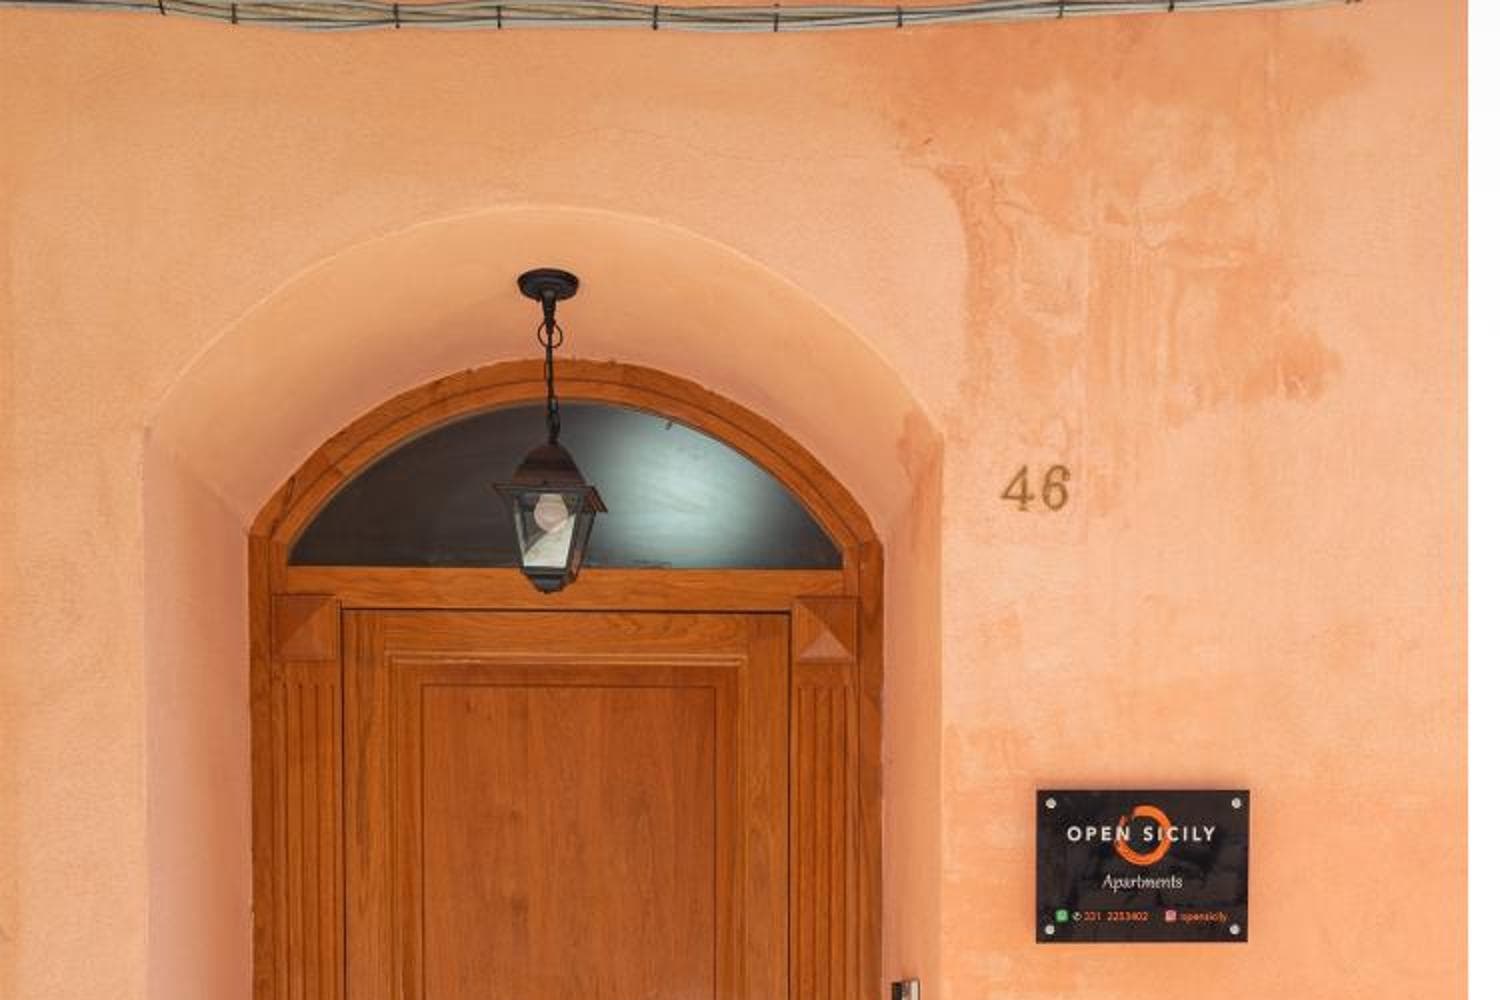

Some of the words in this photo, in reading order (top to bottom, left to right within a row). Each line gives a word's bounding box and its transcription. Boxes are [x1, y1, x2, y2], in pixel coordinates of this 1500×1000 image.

[1000, 464, 1070, 512] 46
[1066, 825, 1131, 842] OPEN
[1142, 825, 1216, 842] SICILY
[1102, 873, 1183, 893] Apartments
